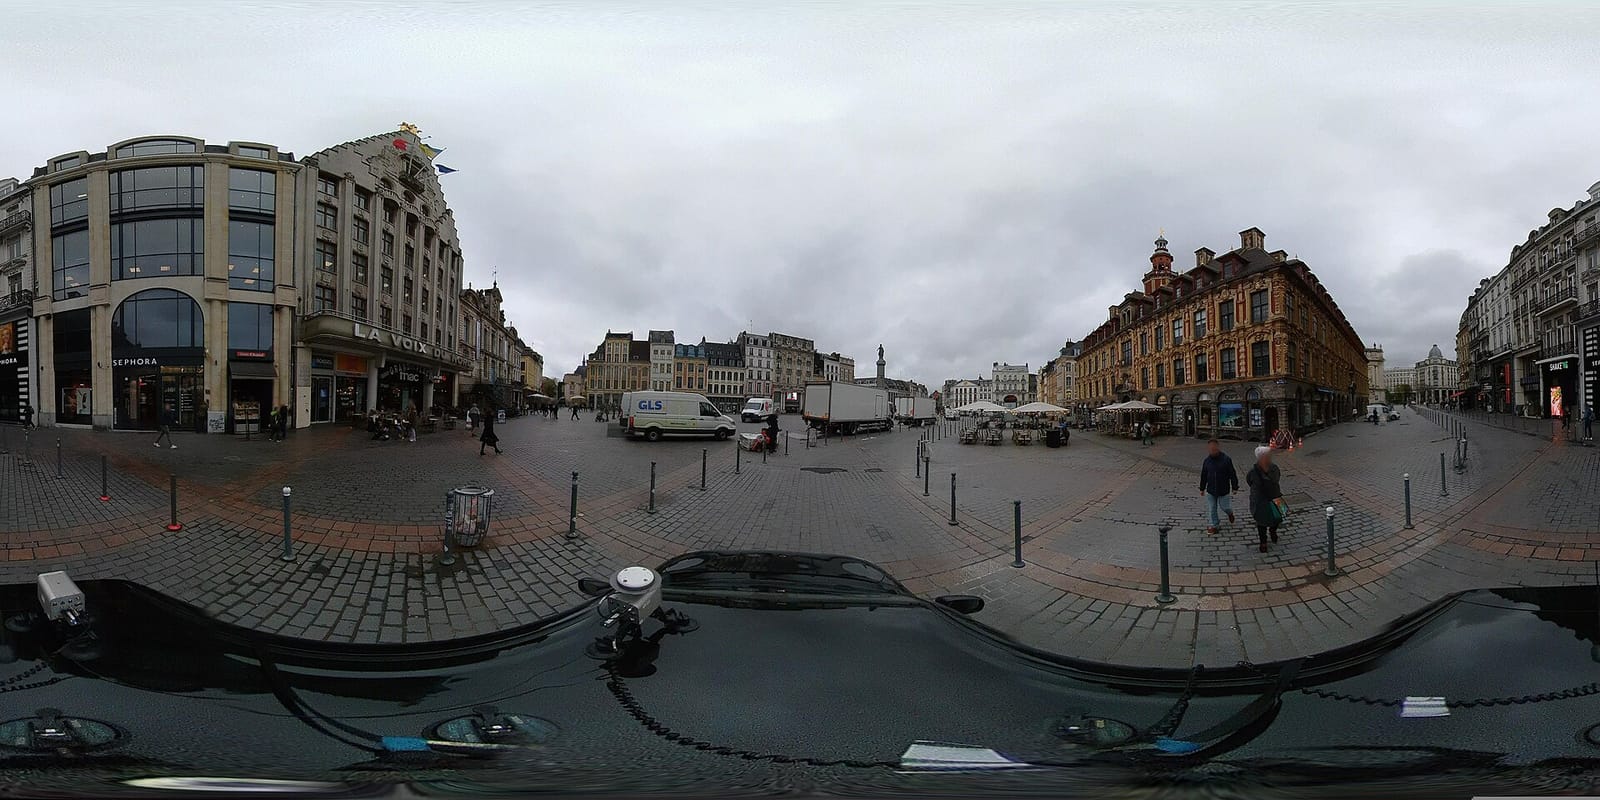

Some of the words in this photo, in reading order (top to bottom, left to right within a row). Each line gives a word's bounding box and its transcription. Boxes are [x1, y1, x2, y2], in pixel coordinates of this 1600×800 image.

[354, 324, 381, 342] LA
[391, 334, 427, 354] VOIX
[434, 350, 447, 360] DU
[112, 357, 158, 367] SEPHORA
[638, 400, 662, 410] GLS
